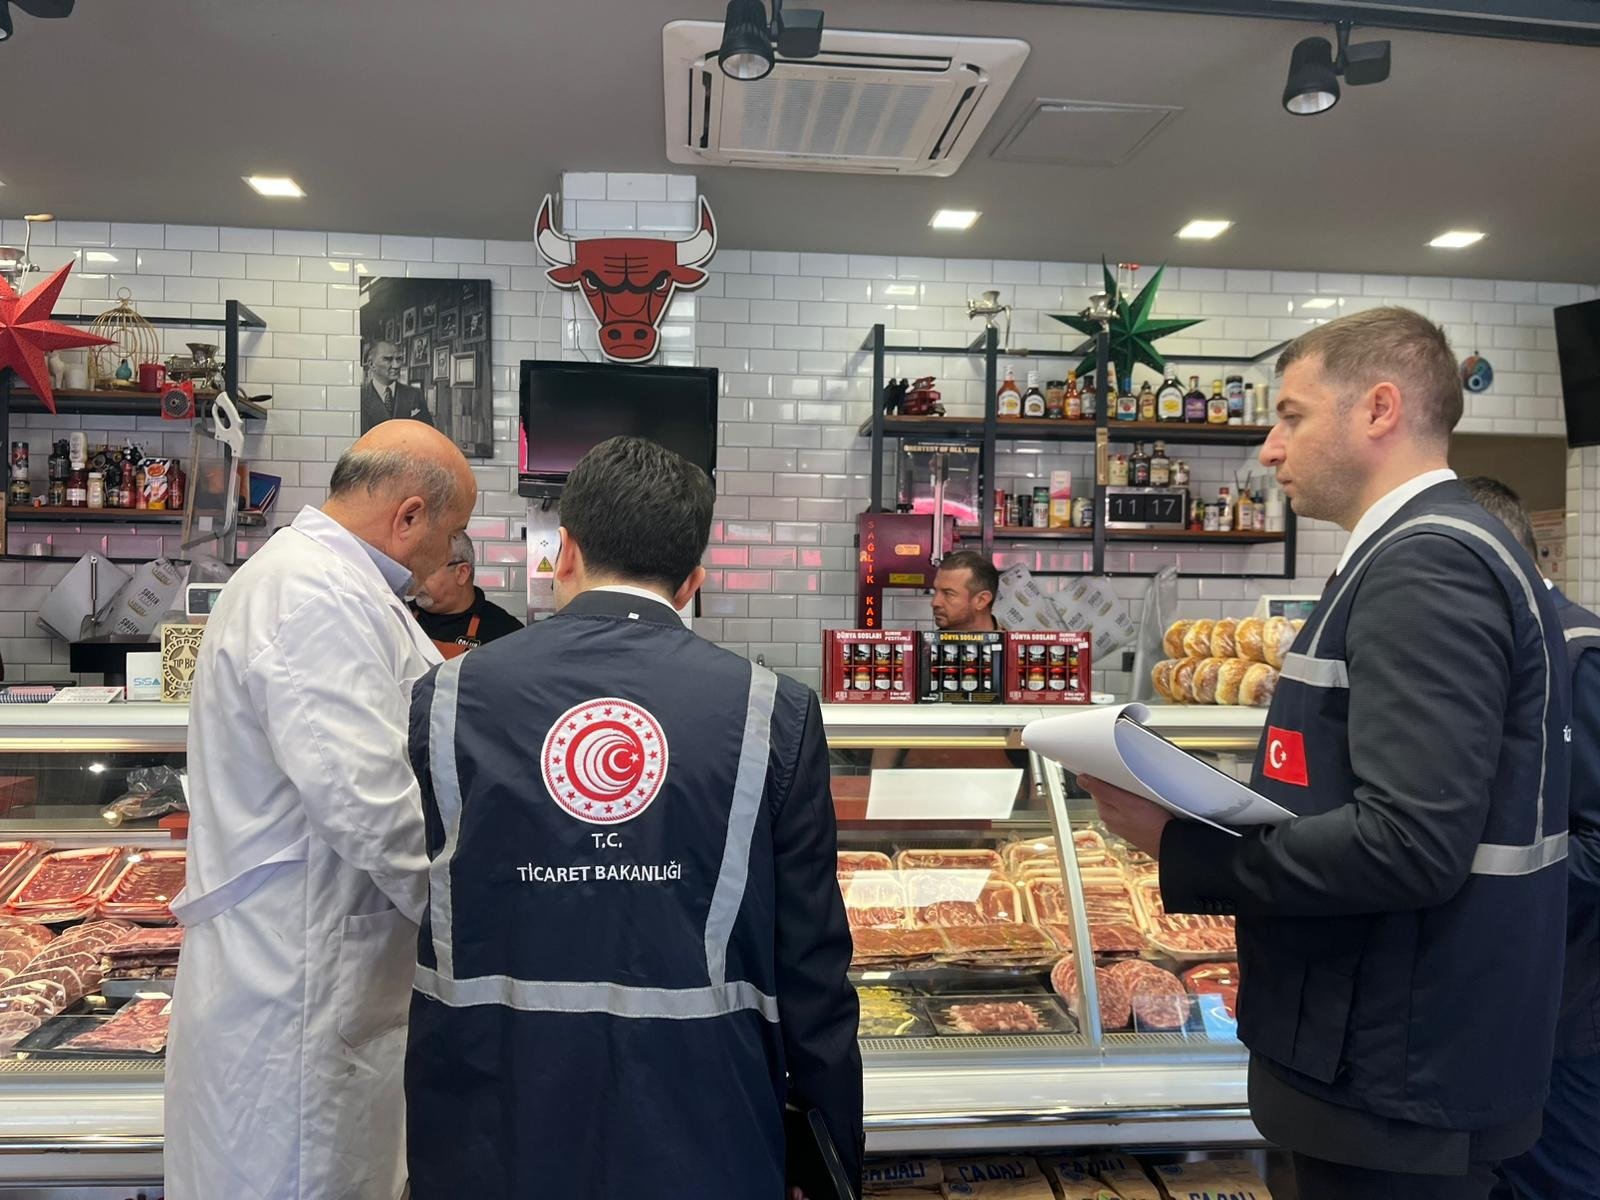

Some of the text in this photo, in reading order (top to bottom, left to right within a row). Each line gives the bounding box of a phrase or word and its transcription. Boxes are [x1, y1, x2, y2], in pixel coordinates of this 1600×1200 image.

[1115, 499, 1176, 516] 11 17
[173, 660, 196, 669] TIP BO
[591, 833, 623, 849] T.C.
[516, 860, 681, 882] TİCARET BAKANLIĞI
